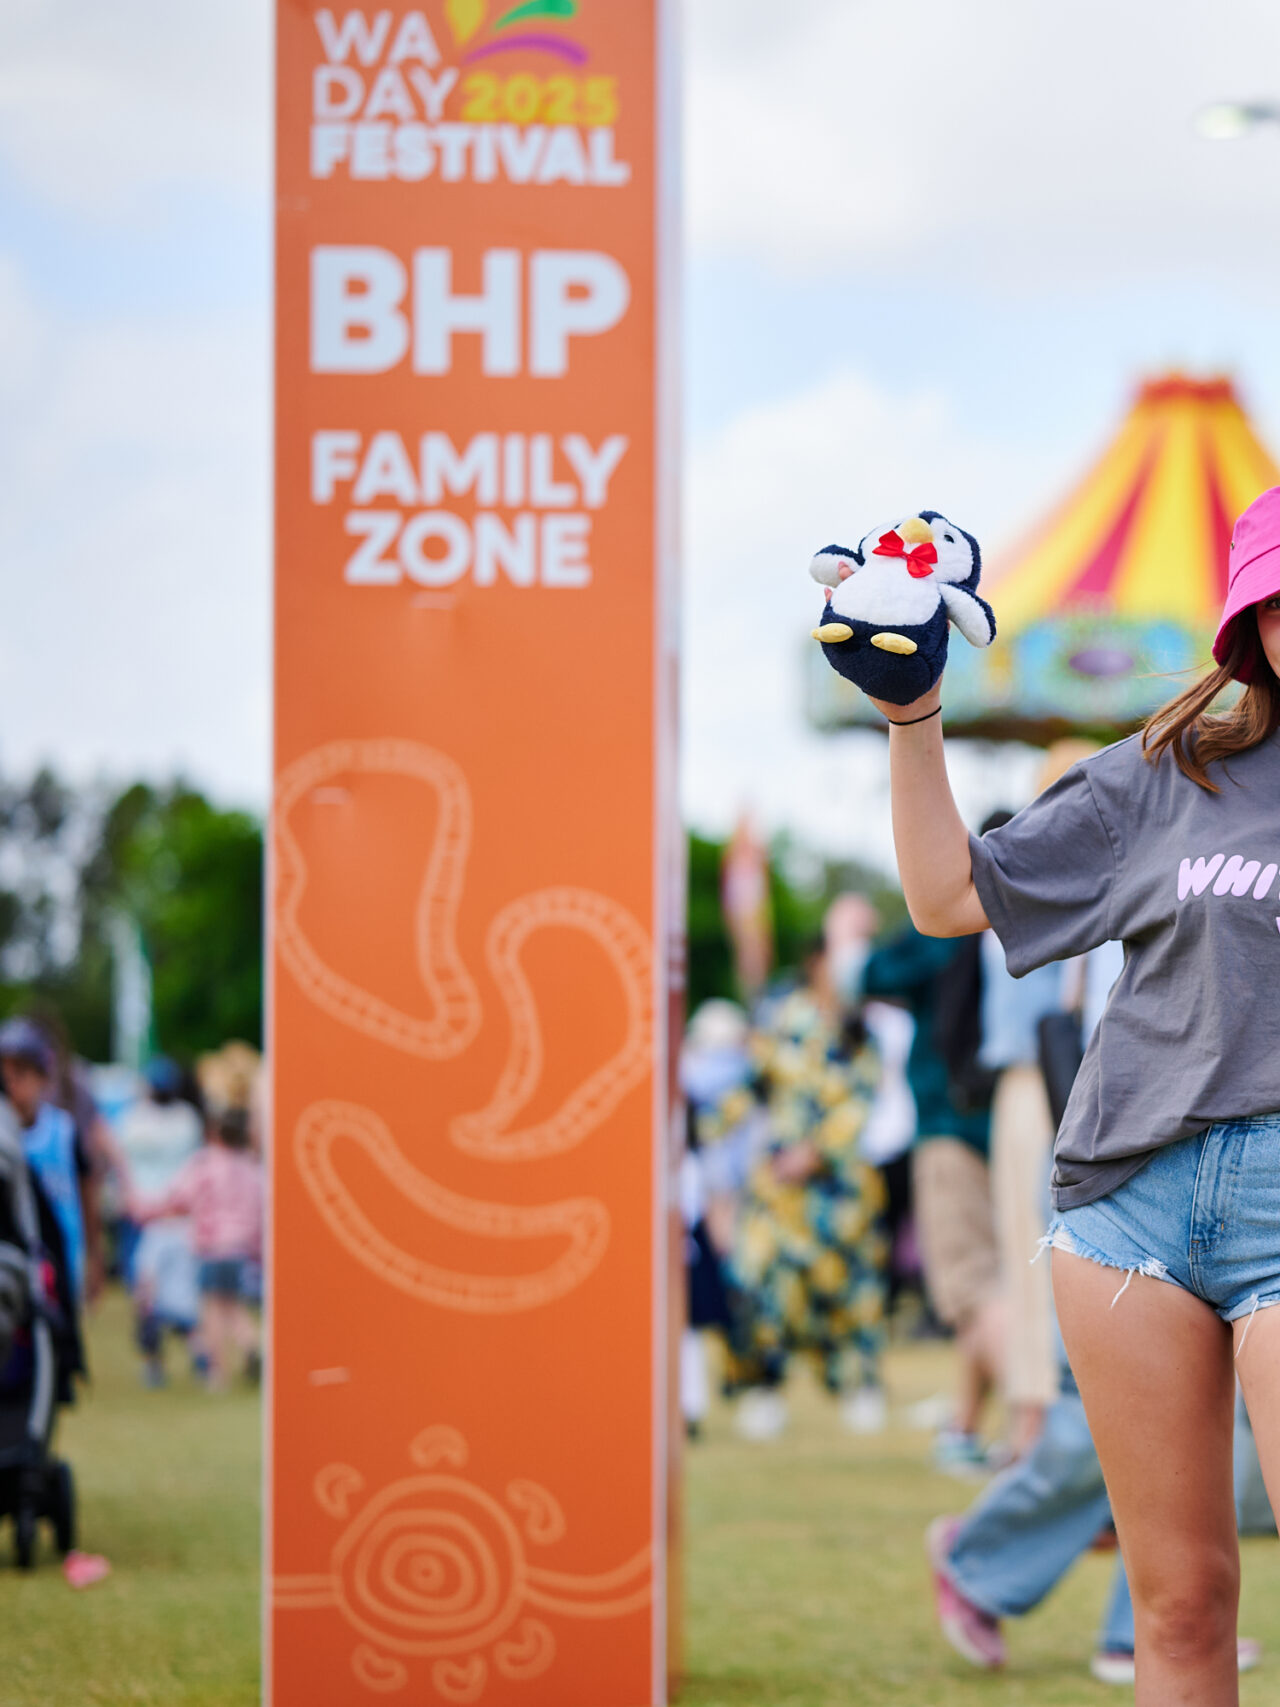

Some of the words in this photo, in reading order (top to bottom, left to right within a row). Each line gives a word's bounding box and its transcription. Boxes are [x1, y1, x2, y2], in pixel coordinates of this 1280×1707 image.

[314, 8, 442, 66] WA
[312, 62, 459, 122] DAY
[460, 71, 618, 127] 2025
[310, 120, 632, 188] FESTIVAL
[309, 245, 631, 378] BHP
[311, 430, 629, 509] FAMILY
[344, 509, 592, 588] ZONE
